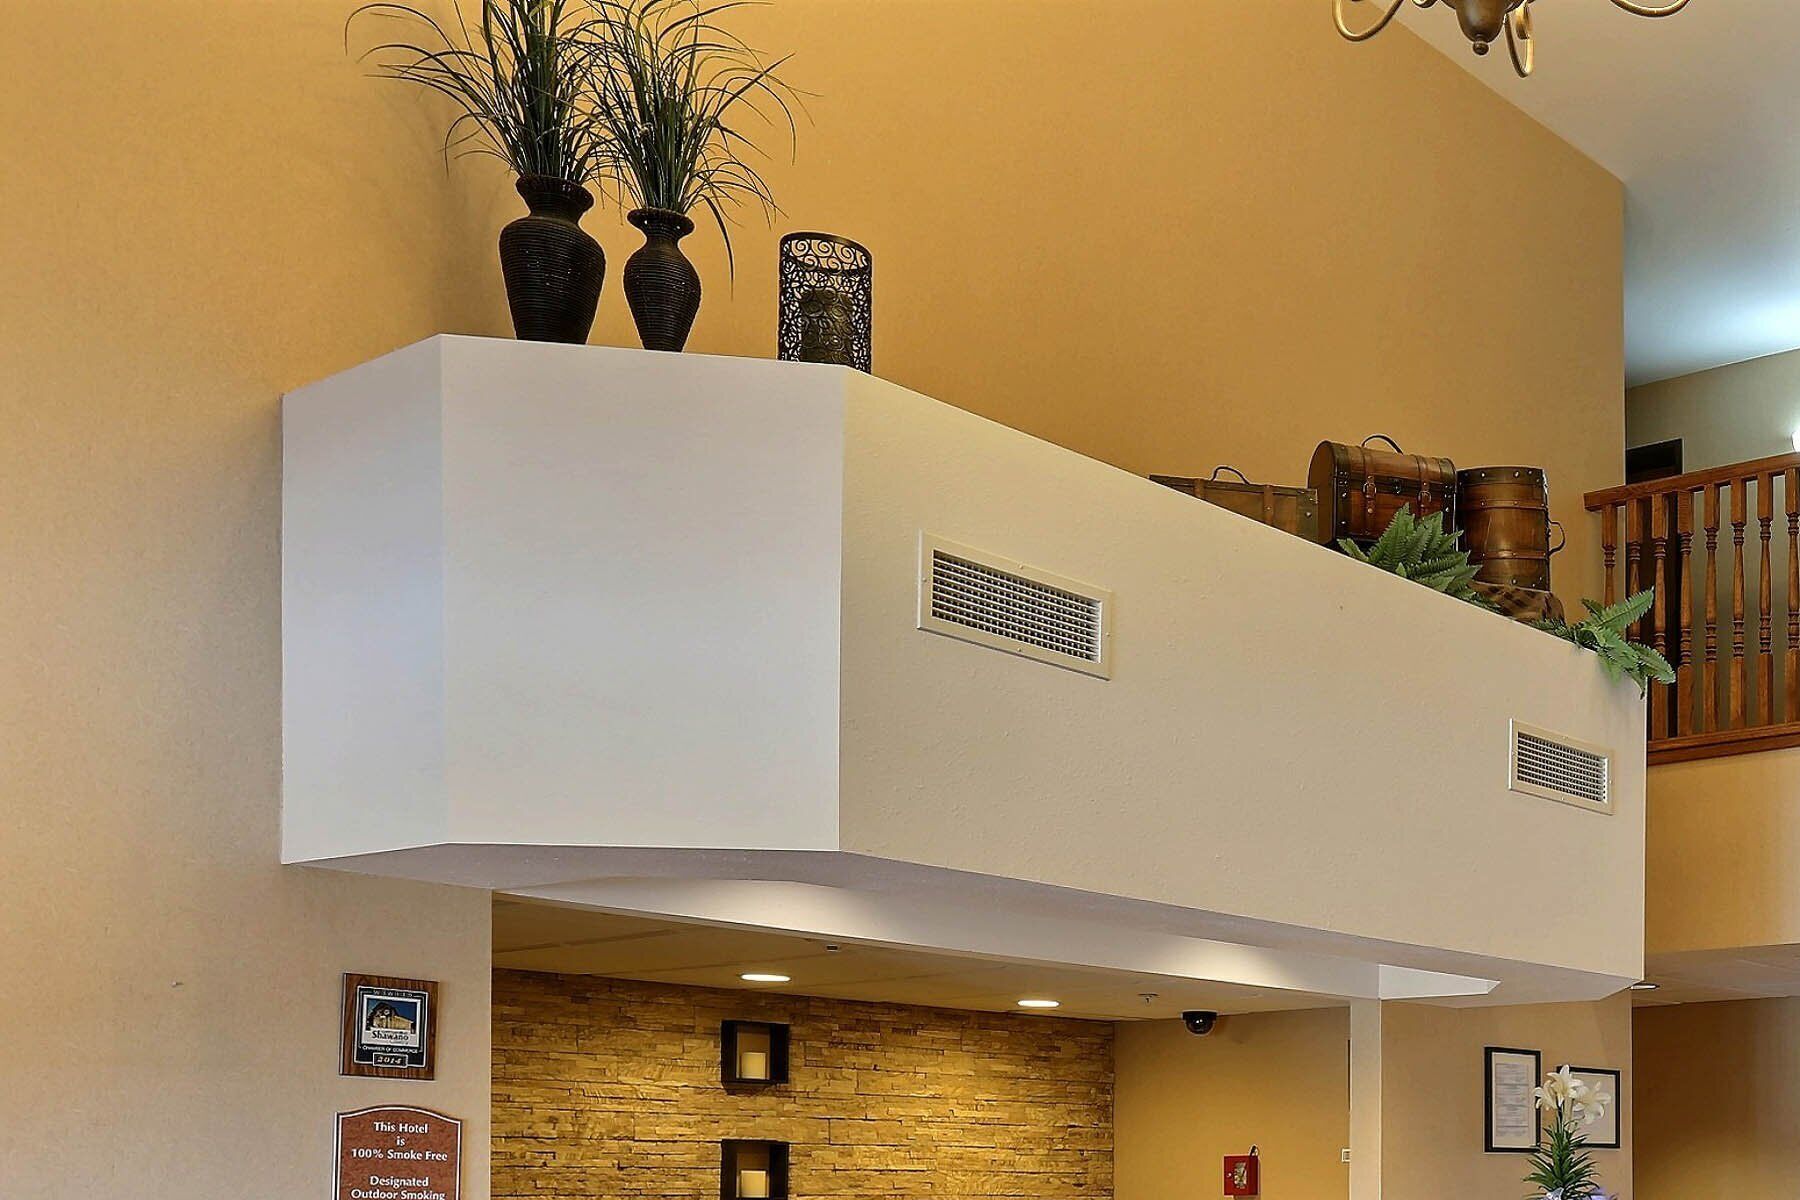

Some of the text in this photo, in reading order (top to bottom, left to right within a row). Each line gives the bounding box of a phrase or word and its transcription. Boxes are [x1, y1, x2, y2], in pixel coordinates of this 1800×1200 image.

[371, 1030, 409, 1041] Shawano
[373, 1121, 428, 1133] This Hotel
[396, 1136, 406, 1146] is
[351, 1149, 448, 1161] 100% Smoke Free
[369, 1175, 429, 1189] Designated
[351, 1189, 398, 1199] Outdoor
